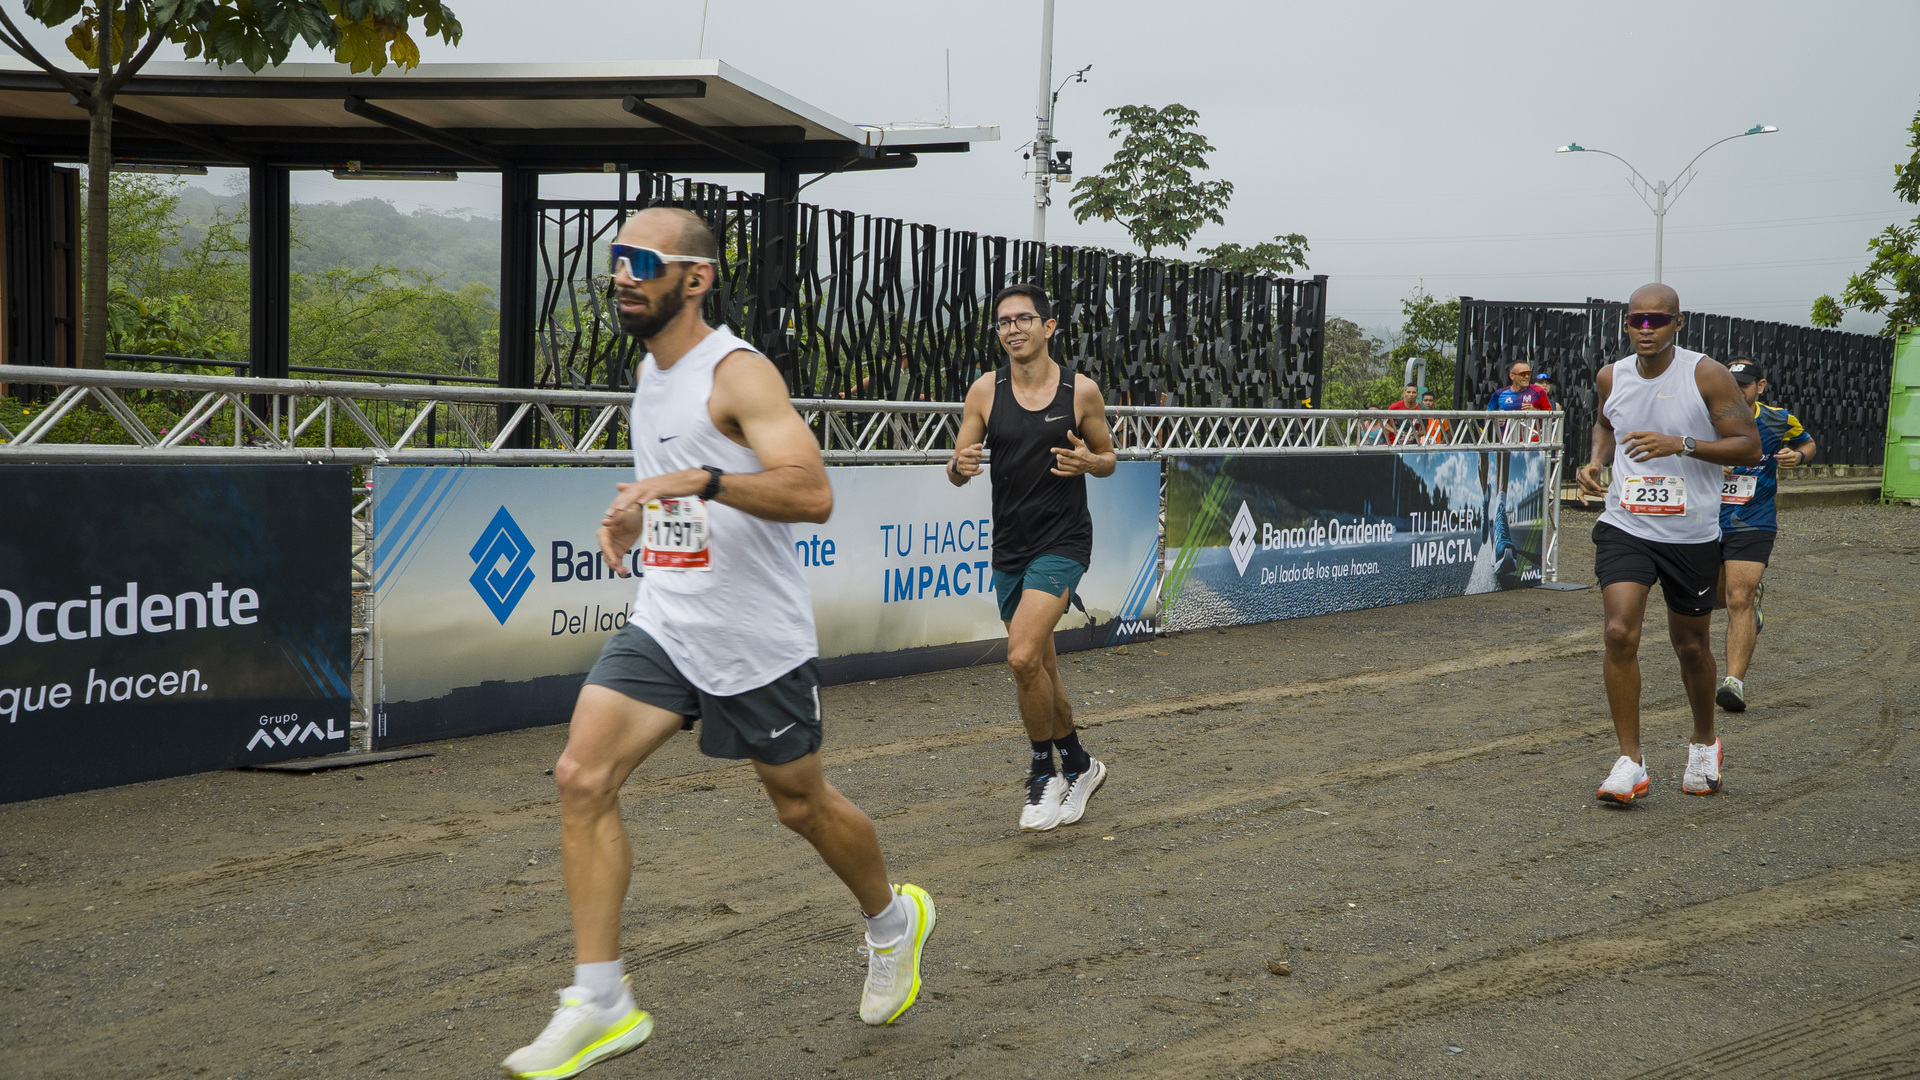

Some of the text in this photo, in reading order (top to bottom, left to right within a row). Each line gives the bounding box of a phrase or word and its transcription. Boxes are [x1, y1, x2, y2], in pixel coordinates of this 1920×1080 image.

[1635, 487, 1670, 503] 233
[1721, 482, 1738, 495] 28
[653, 521, 692, 547] 1797
[1262, 517, 1393, 551] Banco de Occidente
[1409, 508, 1477, 536] TU HACER,
[880, 519, 990, 558] TU HACE
[1411, 538, 1477, 568] IMPACTA.
[1261, 558, 1380, 585] Del lado de los que hacen.
[1520, 568, 1542, 581] AVAL
[551, 602, 635, 636] Del lad
[1116, 619, 1154, 636] AVAL
[0, 668, 209, 723] que hacen.
[259, 713, 298, 726] Grupo
[246, 718, 345, 752] AVAL
